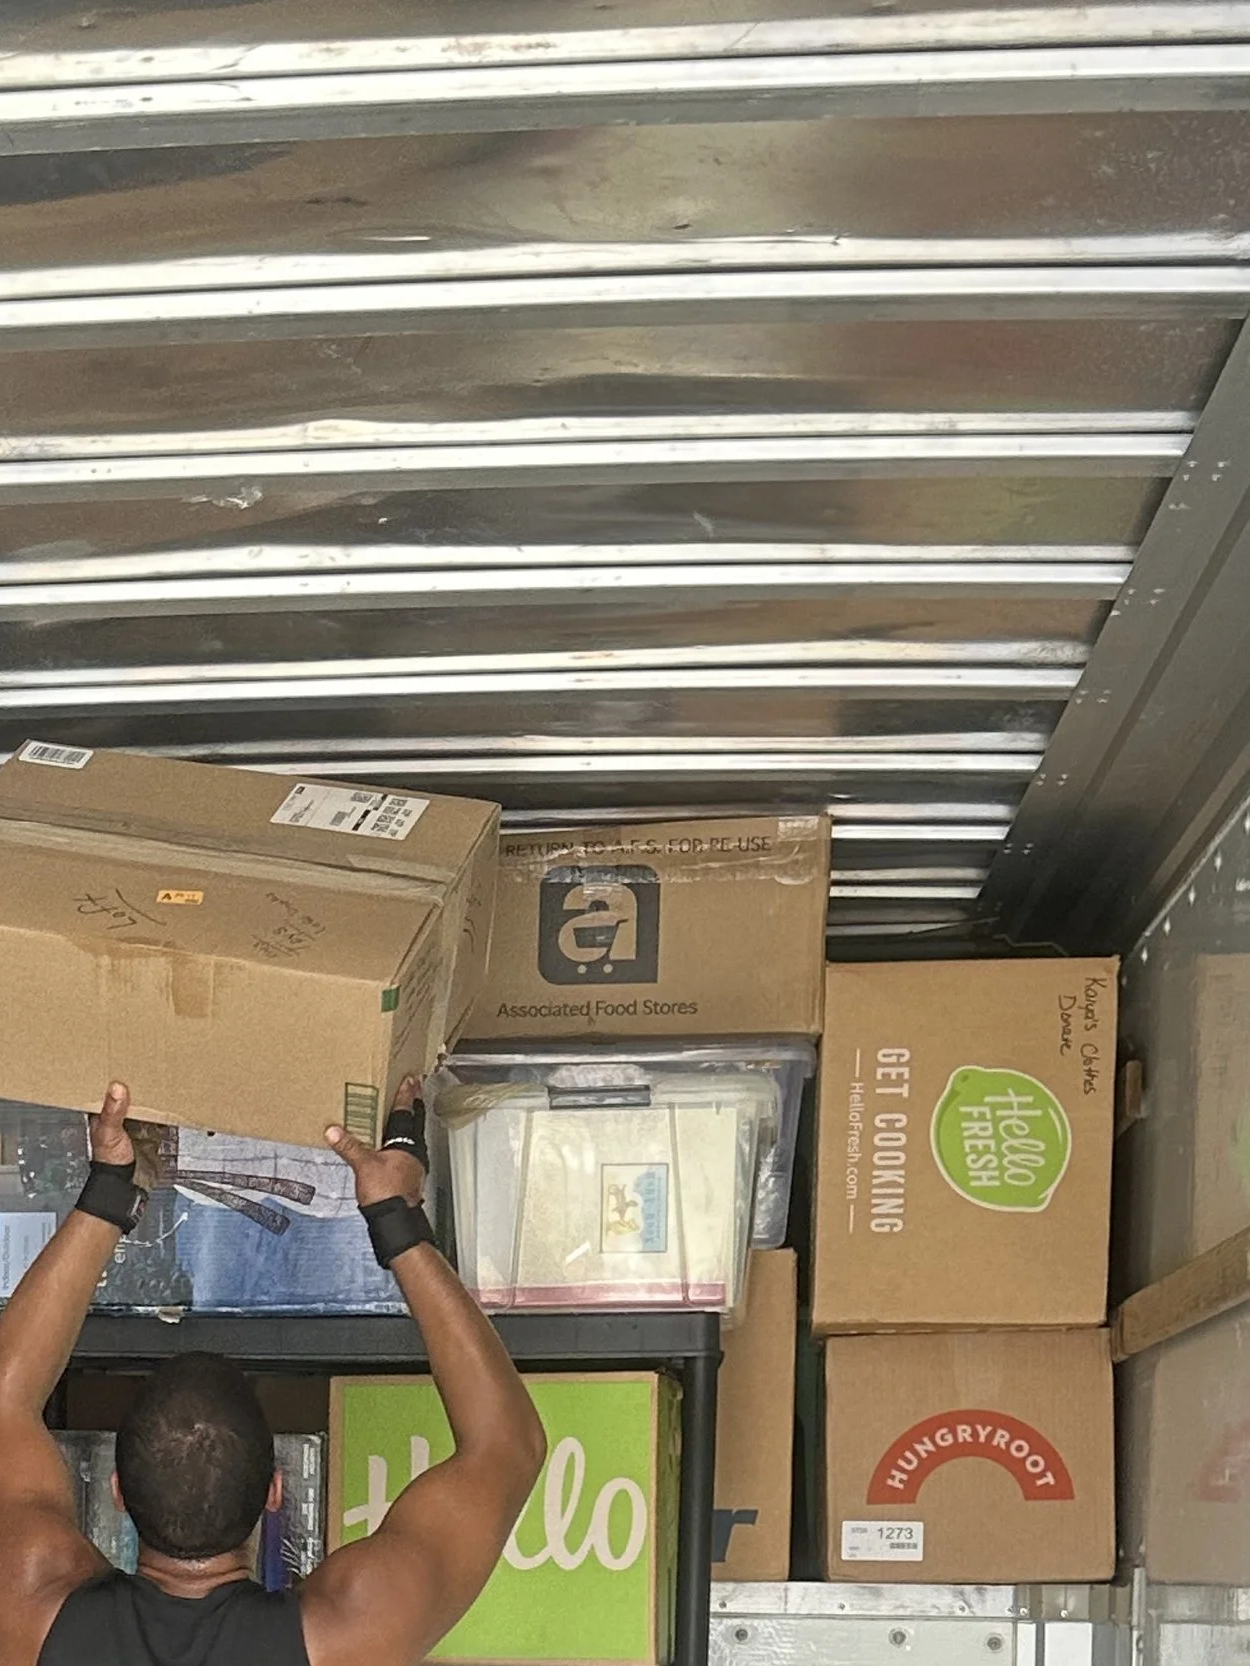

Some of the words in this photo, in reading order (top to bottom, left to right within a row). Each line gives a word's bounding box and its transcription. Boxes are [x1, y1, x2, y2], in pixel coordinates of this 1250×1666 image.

[504, 842, 575, 858] RETURN
[584, 839, 606, 855] TO
[669, 837, 702, 854] FOR
[497, 1000, 590, 1018] Associated
[595, 1000, 637, 1016] Food
[643, 999, 698, 1016] Stores
[875, 1048, 910, 1098] GET
[1080, 1043, 1099, 1095] Clothes
[846, 1083, 864, 1200] HelloFresh.com
[959, 1105, 1001, 1187] FRESH
[983, 1088, 1046, 1187] Hello
[870, 1113, 907, 1233] COOKING
[886, 1424, 1055, 1490] HUNGRYROOT
[877, 1526, 914, 1540] 1273
